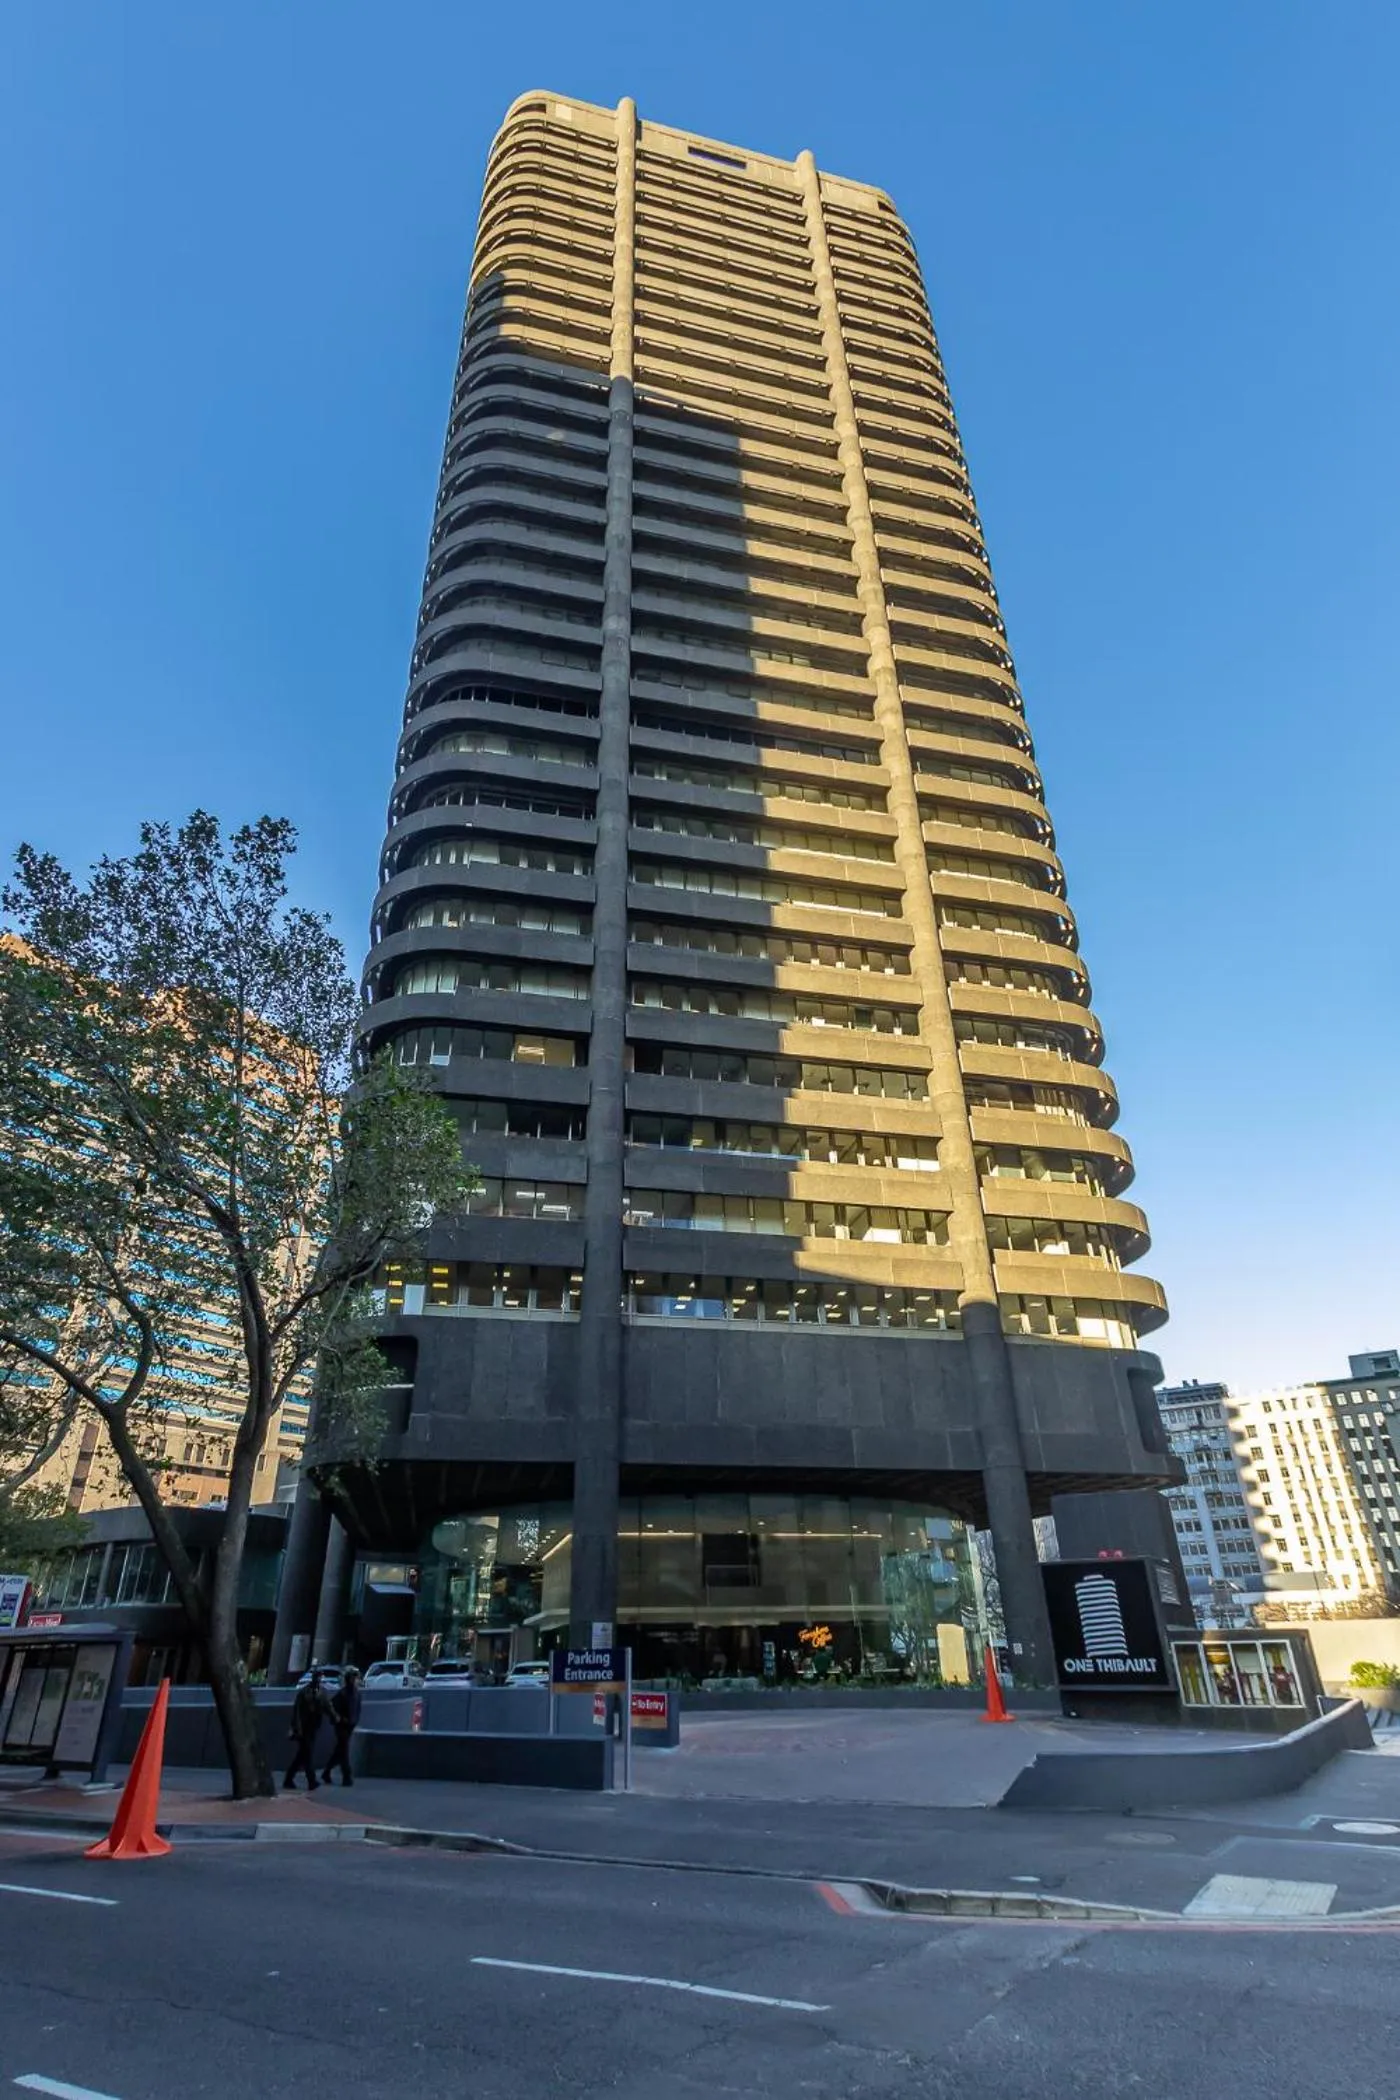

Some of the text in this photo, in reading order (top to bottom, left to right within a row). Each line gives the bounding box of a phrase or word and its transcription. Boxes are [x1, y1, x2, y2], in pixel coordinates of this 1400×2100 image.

[567, 1651, 610, 1667] Parking
[1064, 1658, 1157, 1673] ONE THIBAULT
[564, 1668, 613, 1680] Entrance
[646, 1699, 664, 1711] Entry
